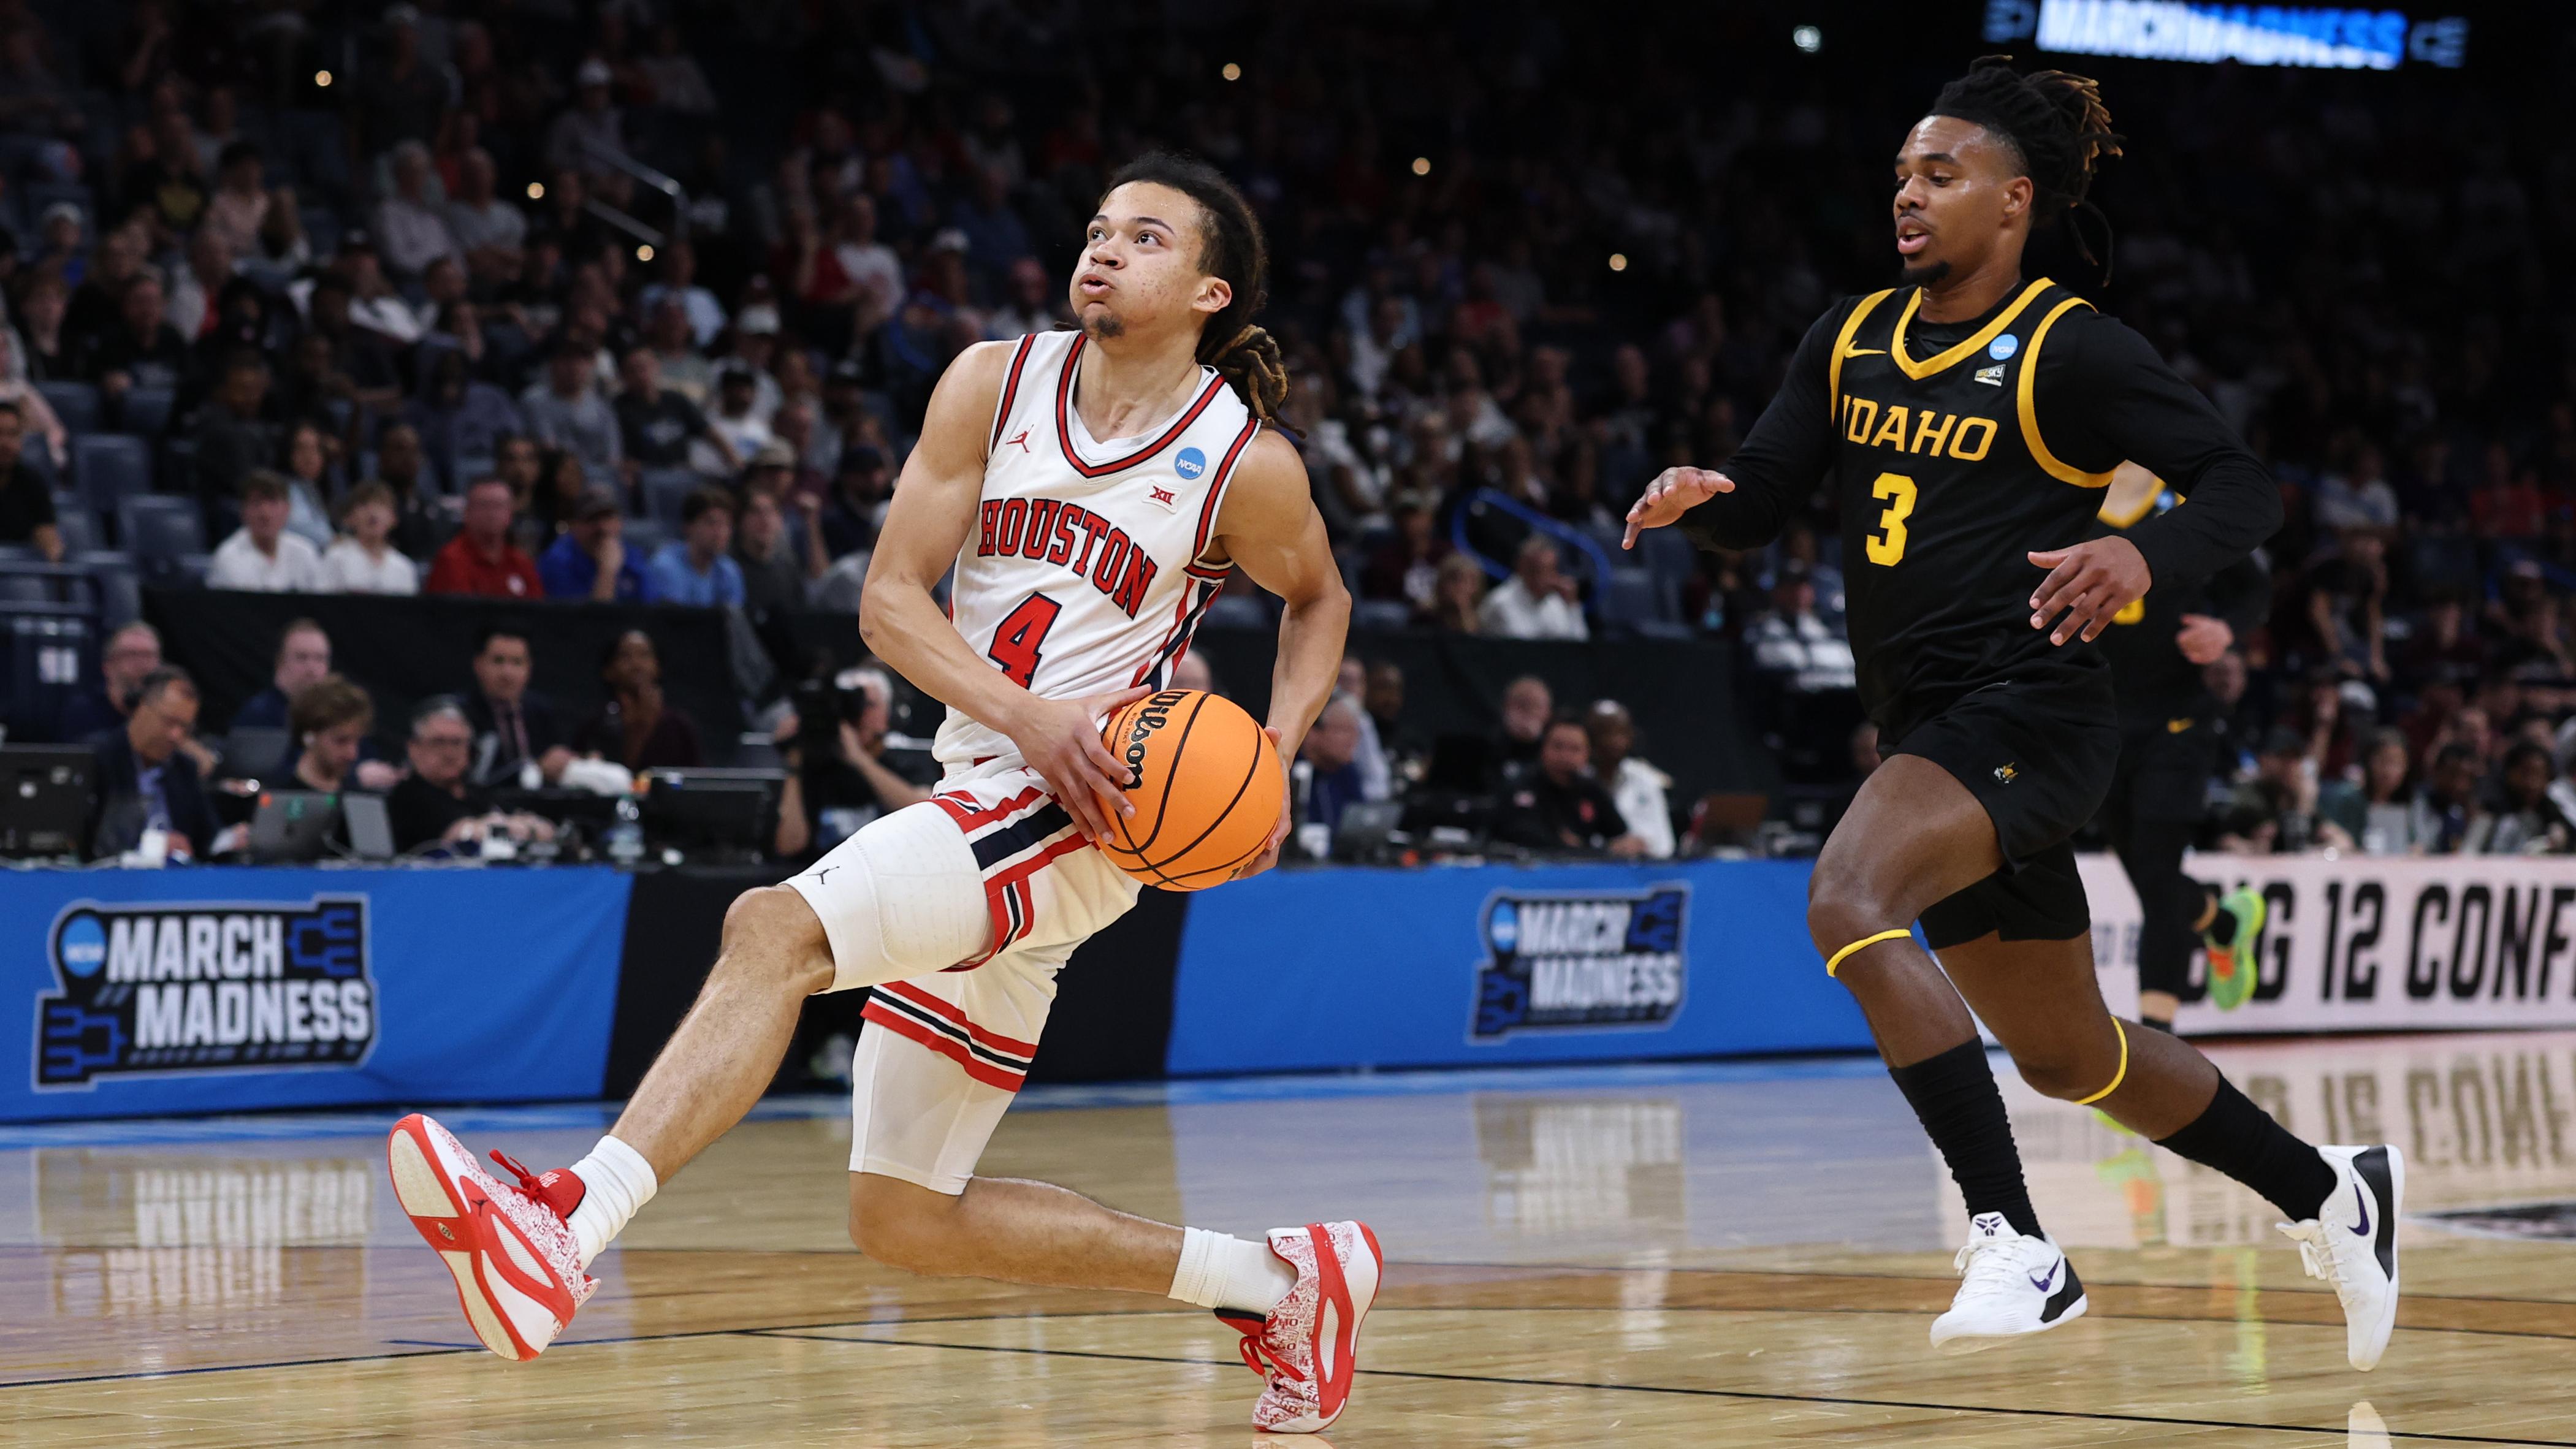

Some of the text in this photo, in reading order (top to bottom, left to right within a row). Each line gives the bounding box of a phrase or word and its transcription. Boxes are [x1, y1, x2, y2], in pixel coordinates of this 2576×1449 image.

[1149, 485, 1175, 506] XII
[1177, 458, 1202, 474] NCAA
[1865, 472, 1918, 567] 3
[977, 498, 1158, 621] HOUSTON
[988, 590, 1062, 691] 4
[1122, 691, 1192, 791] Wilson
[108, 915, 283, 981] MARCH
[1516, 902, 1631, 956] MARCH
[2321, 881, 2384, 1002] 12
[2406, 884, 2576, 1003] CONF
[134, 979, 370, 1049] MADNESS
[1530, 953, 1681, 1010] MADNESS
